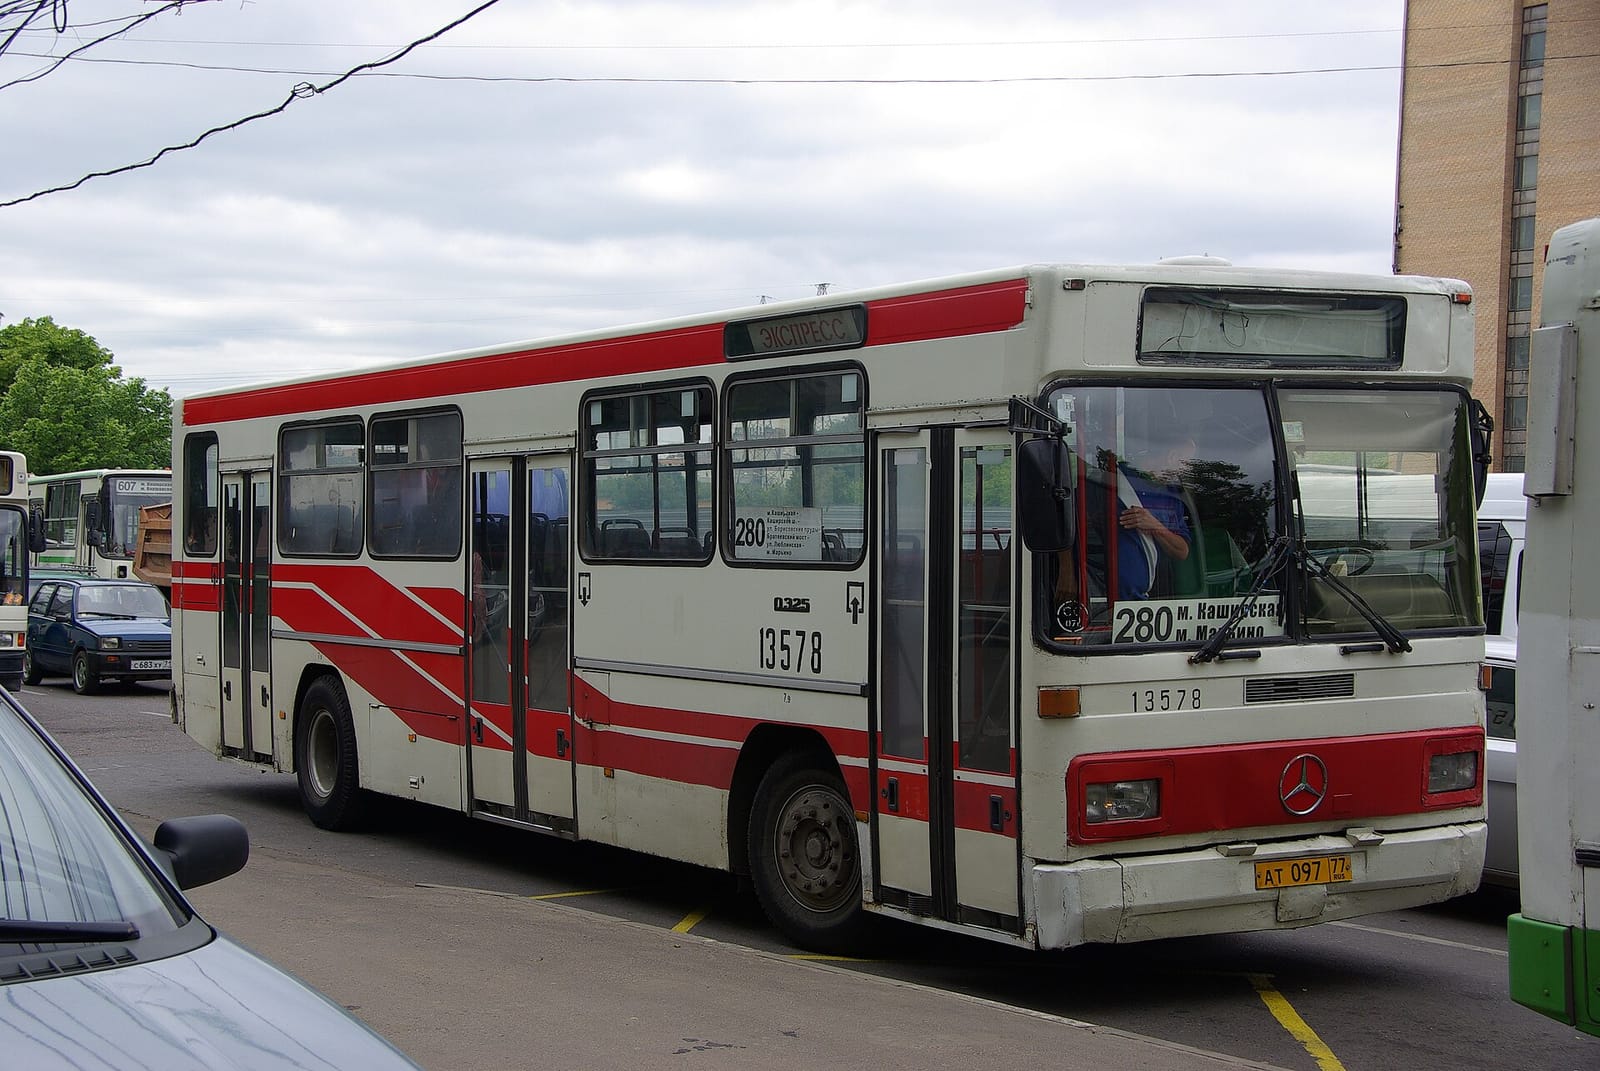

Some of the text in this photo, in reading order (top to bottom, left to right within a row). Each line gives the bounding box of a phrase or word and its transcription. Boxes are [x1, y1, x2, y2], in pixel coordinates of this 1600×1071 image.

[759, 318, 846, 348] ЭКСПРЕСС
[118, 481, 137, 491] 607
[735, 517, 766, 547] 280
[1114, 606, 1173, 643] 280
[1177, 606, 1192, 620] м.
[759, 627, 822, 674] 13578
[1132, 688, 1201, 713] 13578
[1291, 861, 1321, 882] 097
[1330, 858, 1346, 873] 77
